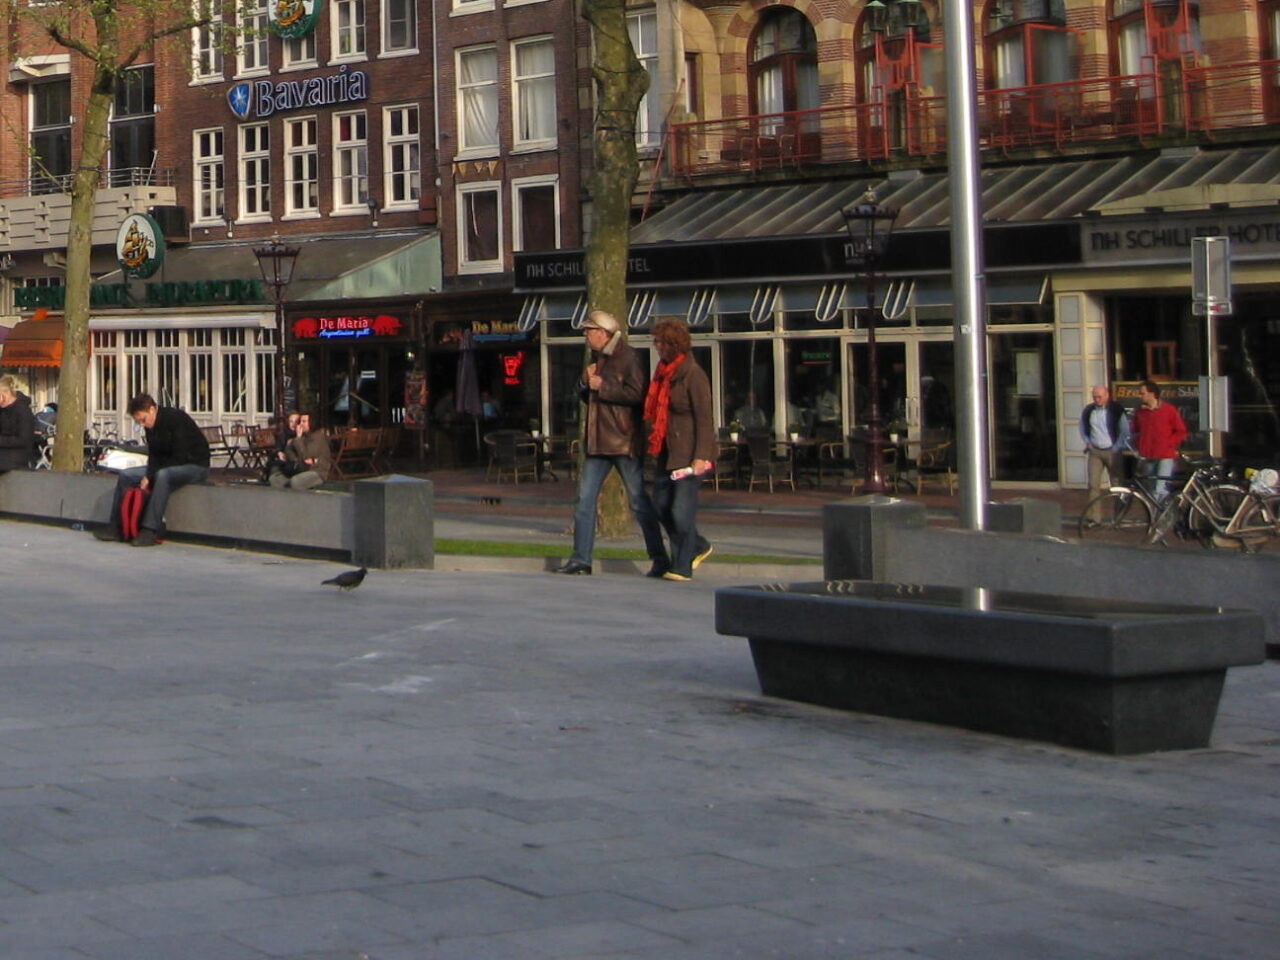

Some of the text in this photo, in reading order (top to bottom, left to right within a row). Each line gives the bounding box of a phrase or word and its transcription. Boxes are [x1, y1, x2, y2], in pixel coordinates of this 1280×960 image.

[255, 65, 368, 118] Bavaria
[320, 317, 368, 330] De Maria
[472, 320, 520, 335] De Mari
